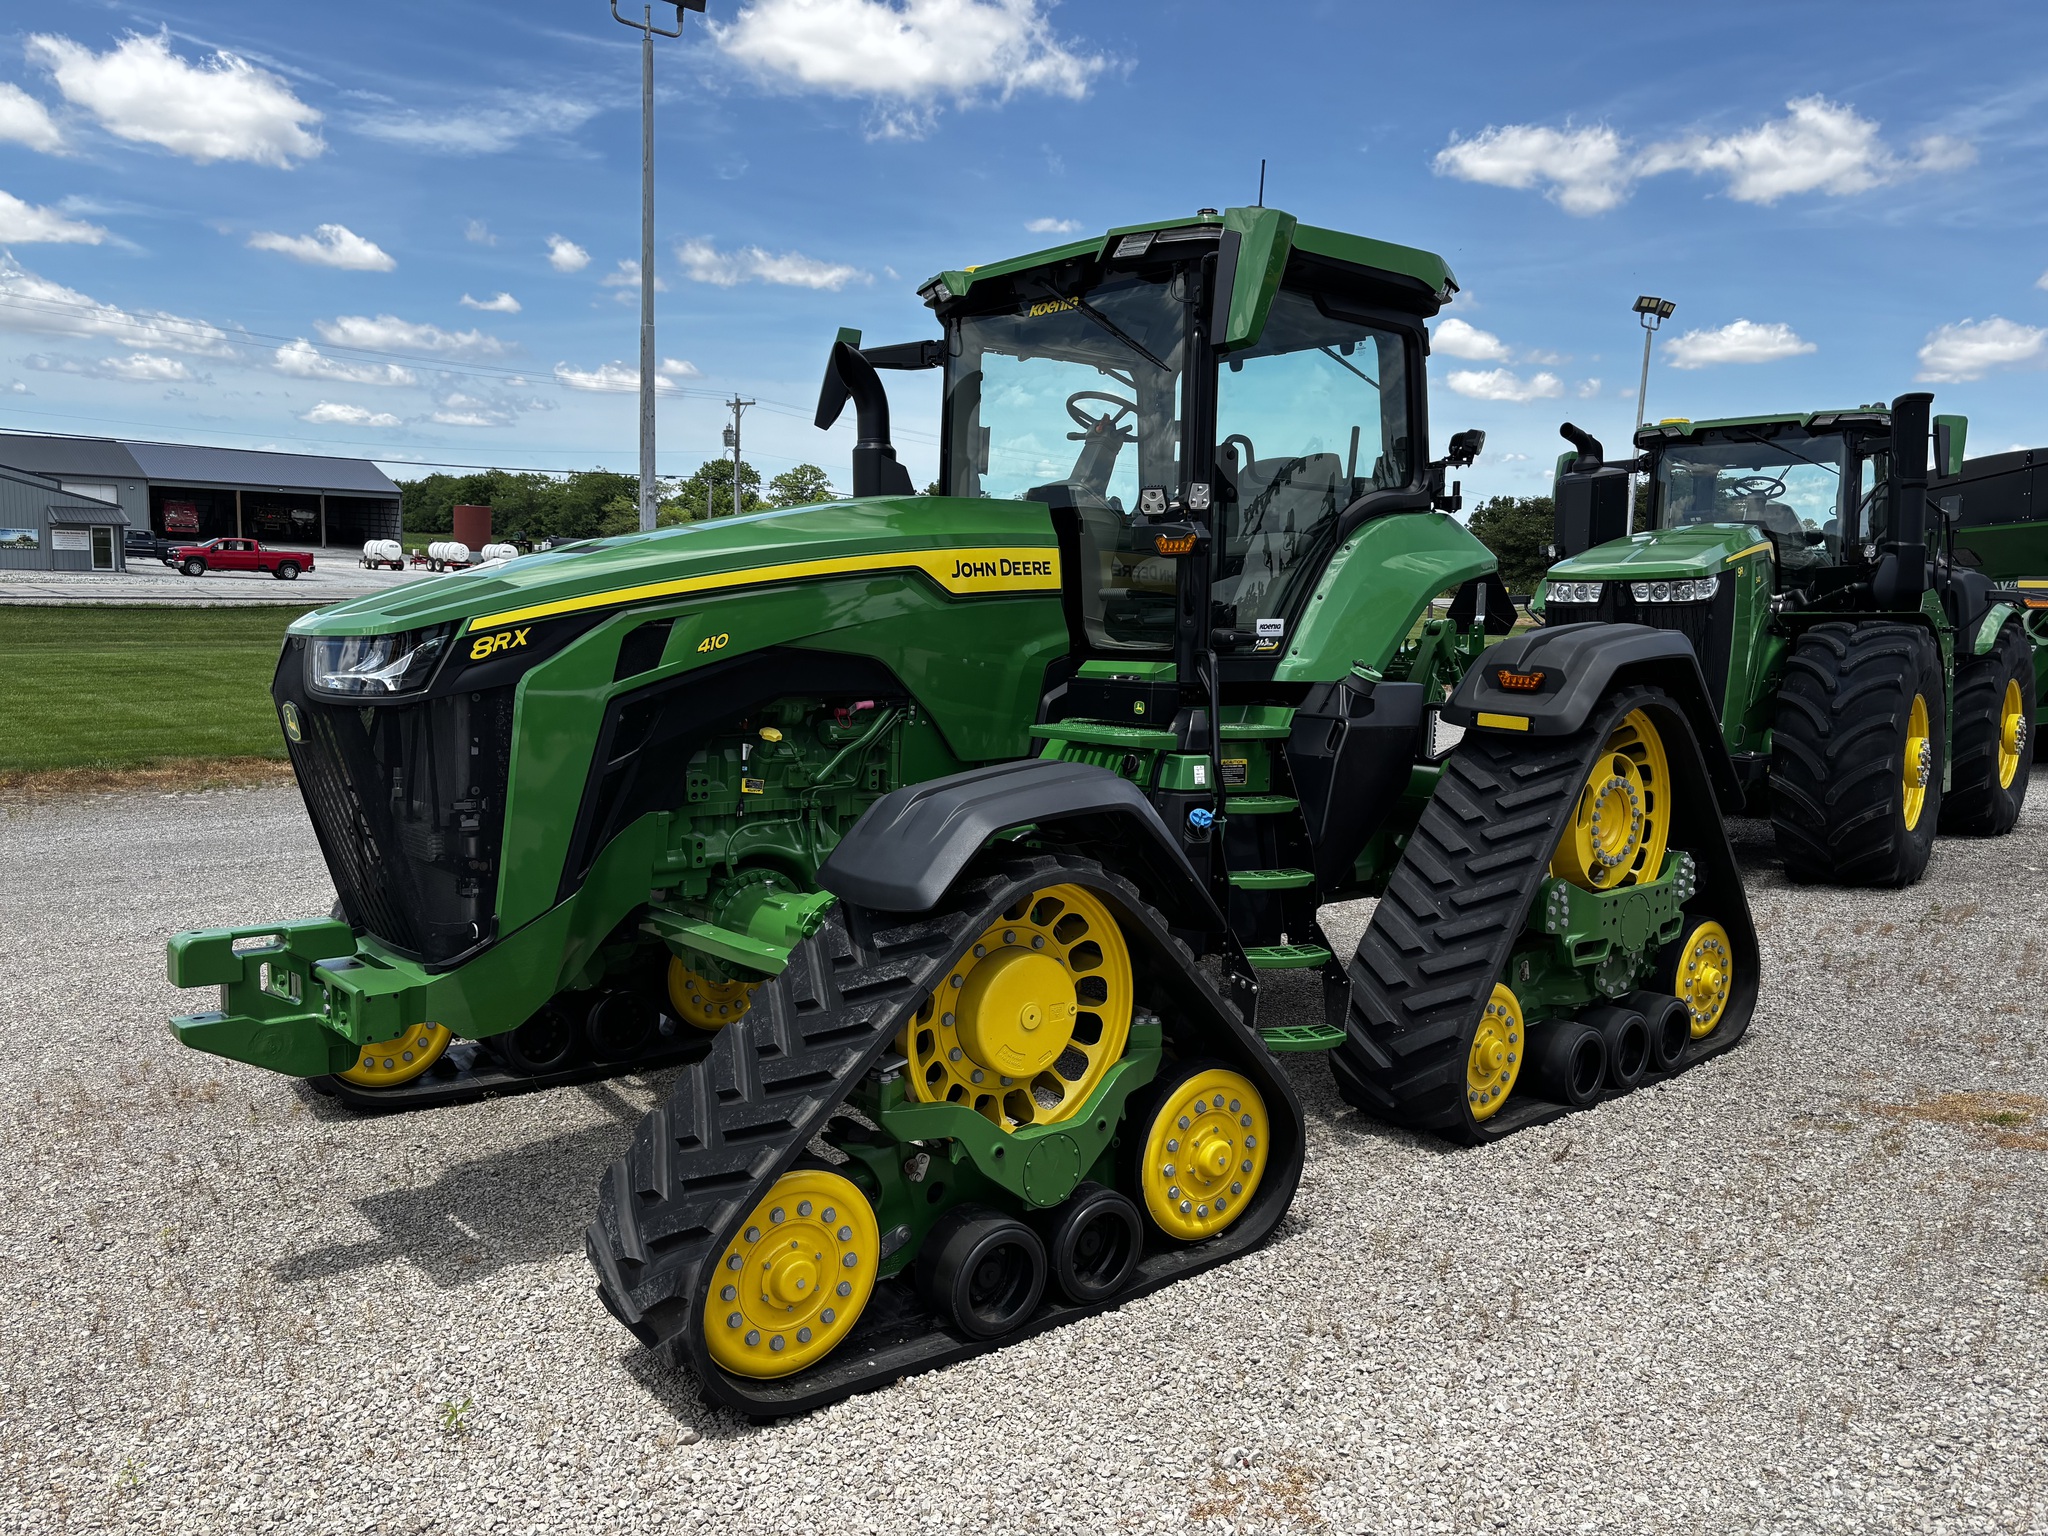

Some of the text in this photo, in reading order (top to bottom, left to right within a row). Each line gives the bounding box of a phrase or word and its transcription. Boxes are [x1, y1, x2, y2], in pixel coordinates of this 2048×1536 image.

[951, 558, 1052, 578] JOHN DEERE
[469, 627, 532, 660] 8RX
[697, 632, 730, 653] 410
